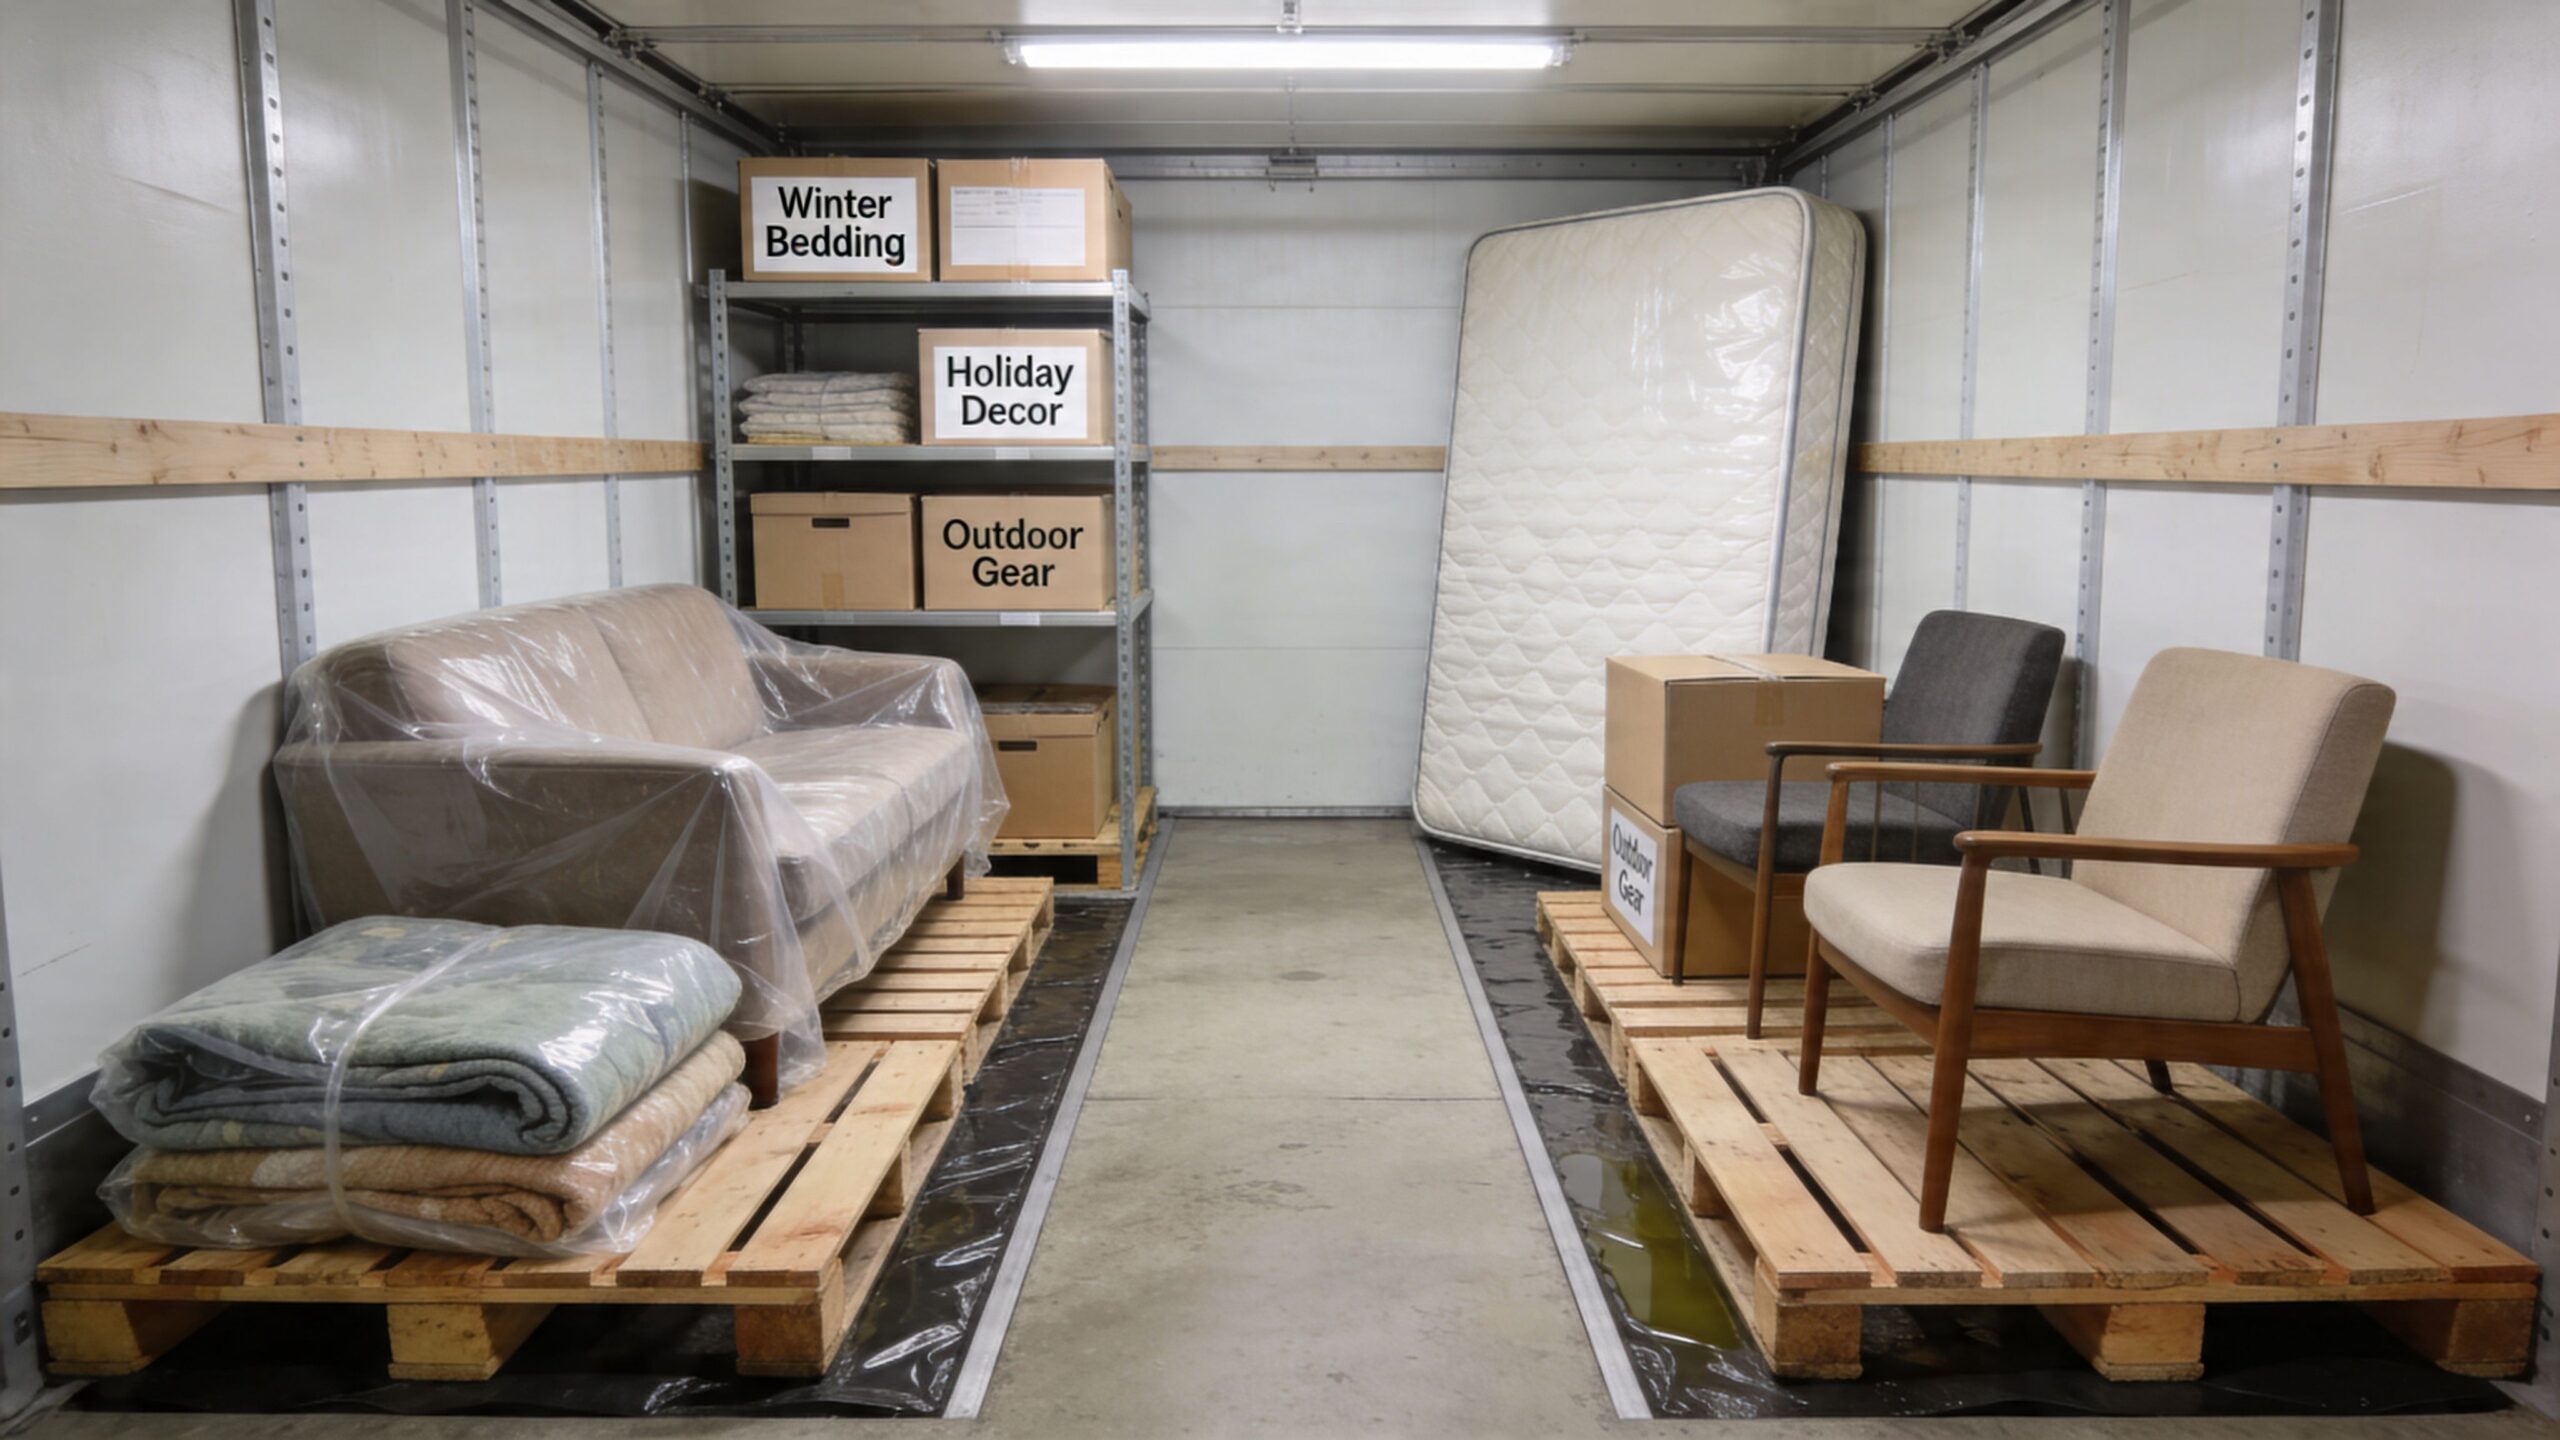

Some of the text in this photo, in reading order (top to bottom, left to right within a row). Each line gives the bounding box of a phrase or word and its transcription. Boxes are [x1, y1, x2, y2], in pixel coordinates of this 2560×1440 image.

[777, 186, 892, 219] Winter
[766, 225, 905, 266] Bedding
[947, 355, 1074, 395] Holiday
[962, 396, 1063, 426] Decor
[942, 518, 1084, 550] Outdoor
[972, 557, 1056, 587] Gear
[1618, 868, 1646, 916] Gear
